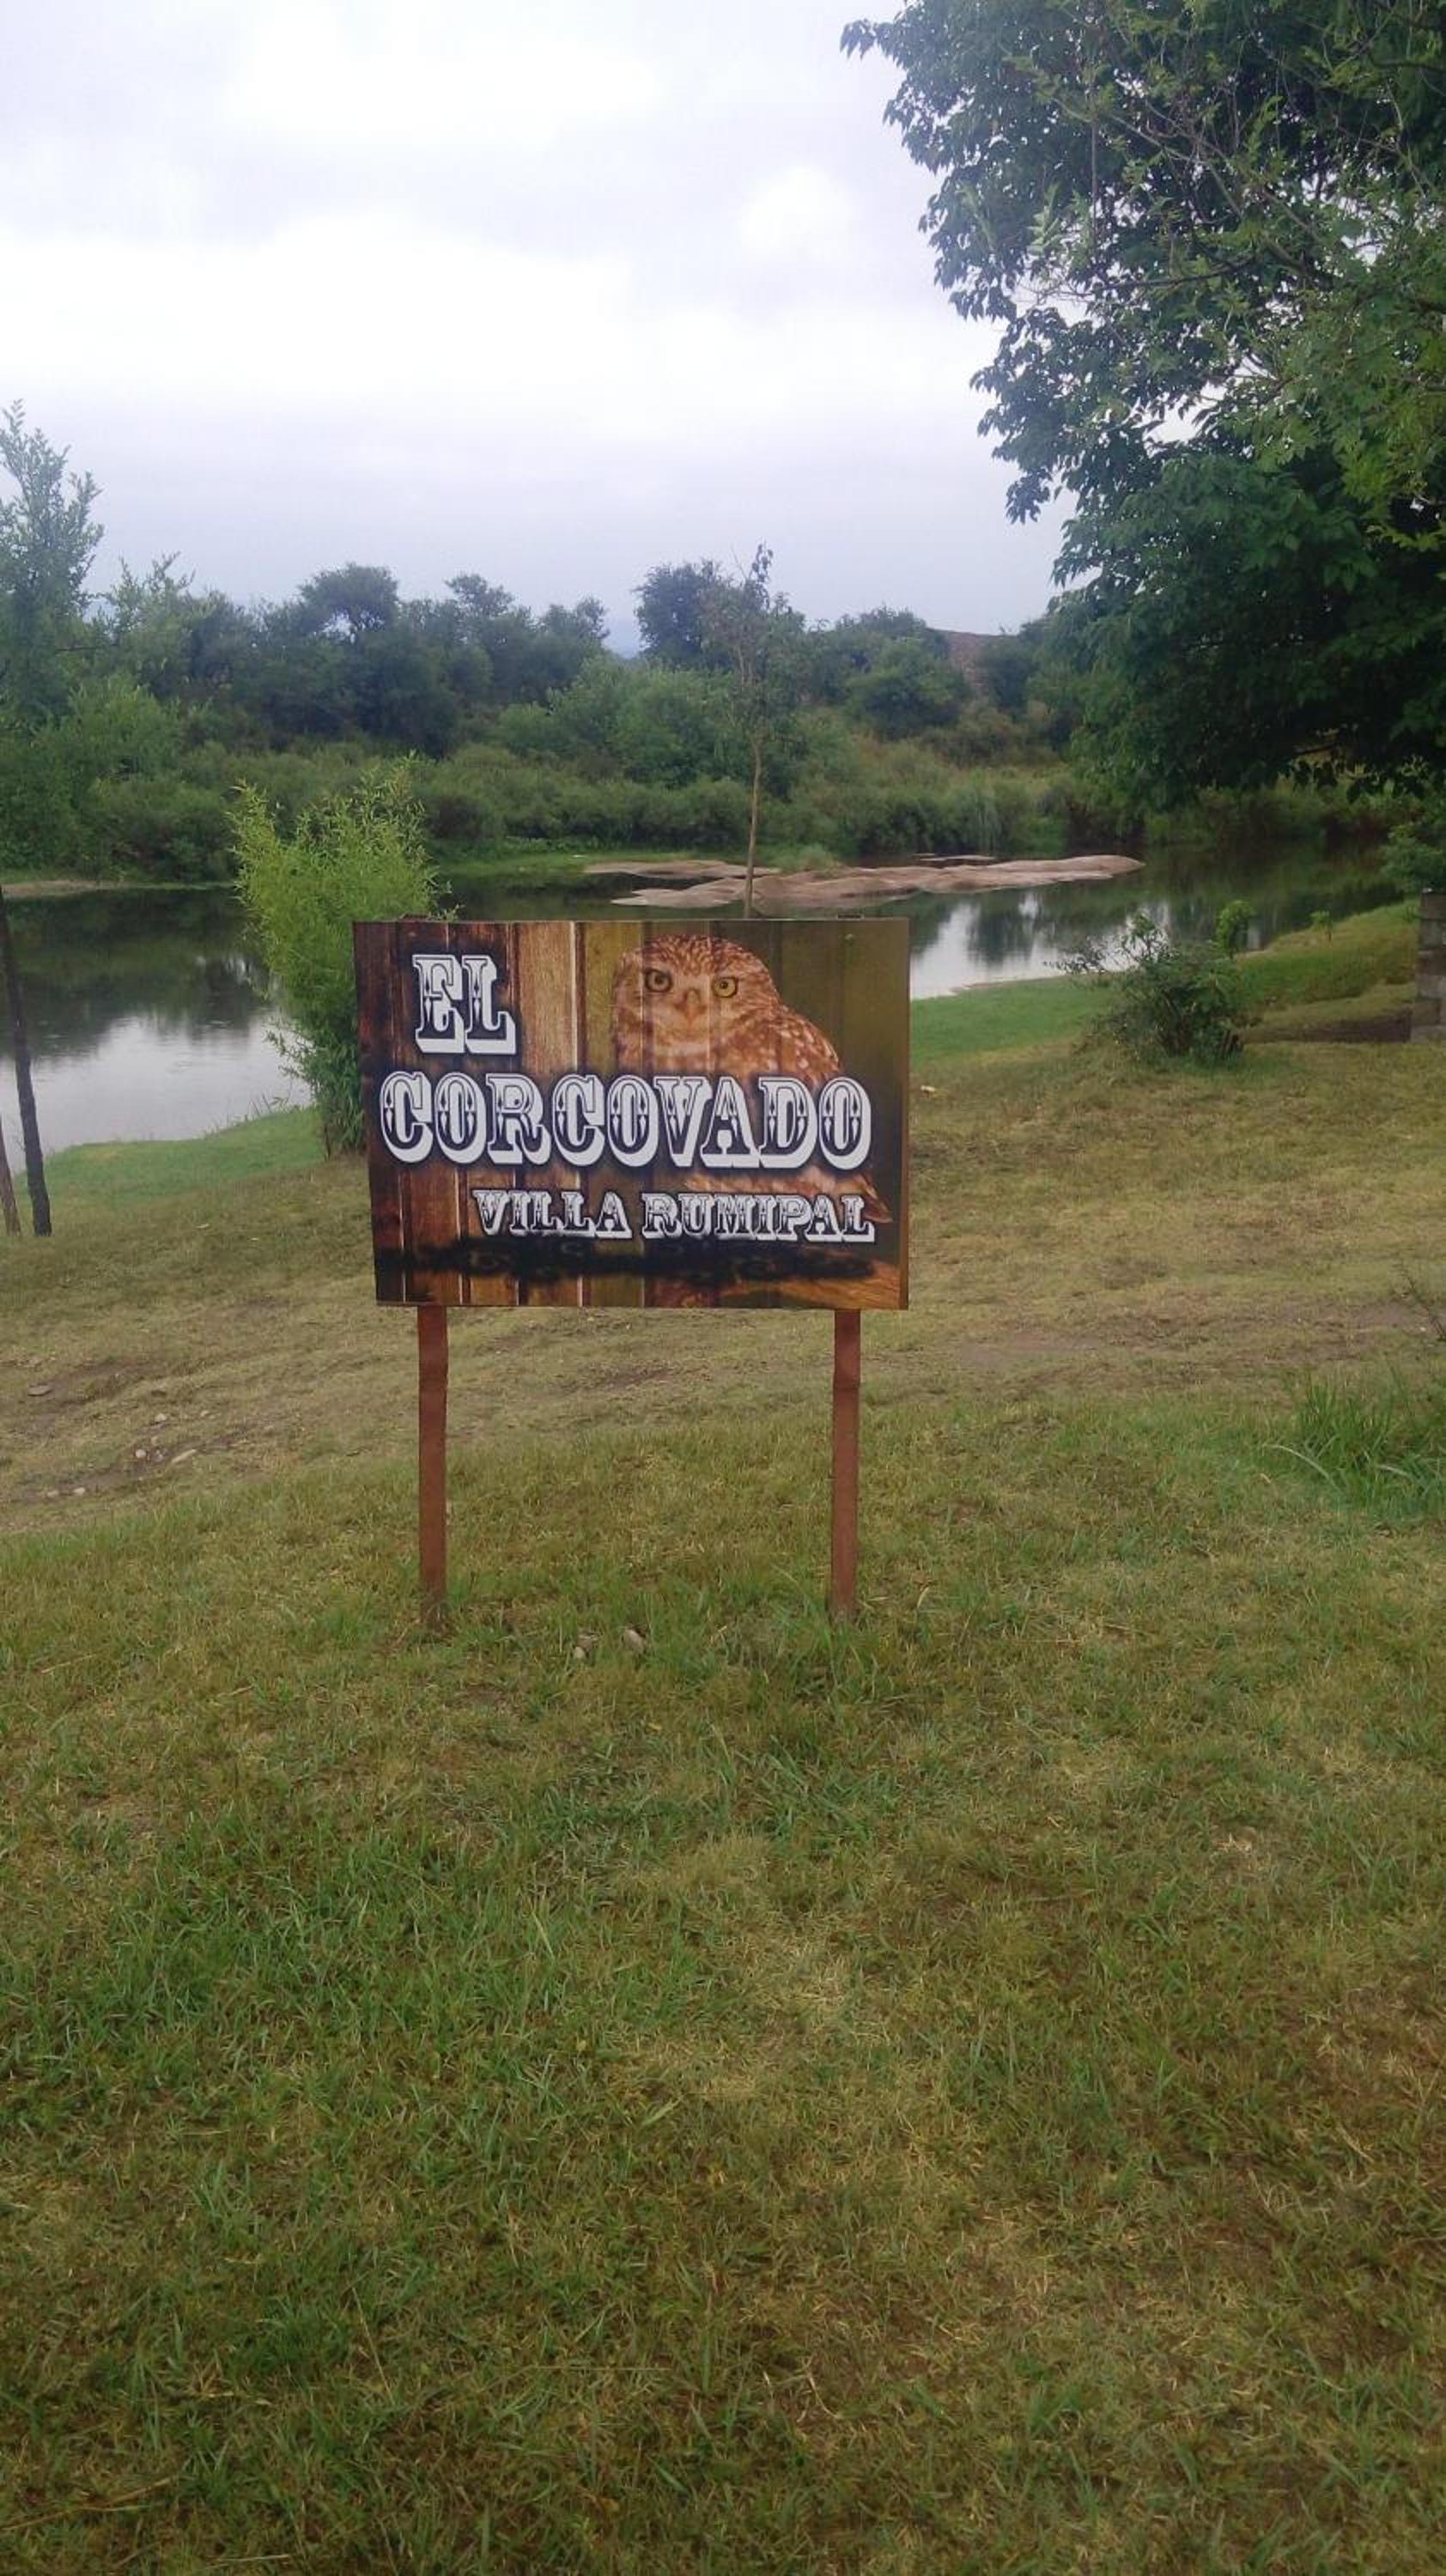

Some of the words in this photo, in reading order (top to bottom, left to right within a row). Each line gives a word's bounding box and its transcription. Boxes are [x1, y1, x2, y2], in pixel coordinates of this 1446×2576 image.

[412, 954, 516, 1054] EL
[379, 1071, 872, 1170] CORCOVADO
[472, 1189, 632, 1239] VILLA
[641, 1193, 875, 1242] RUMIPAL
